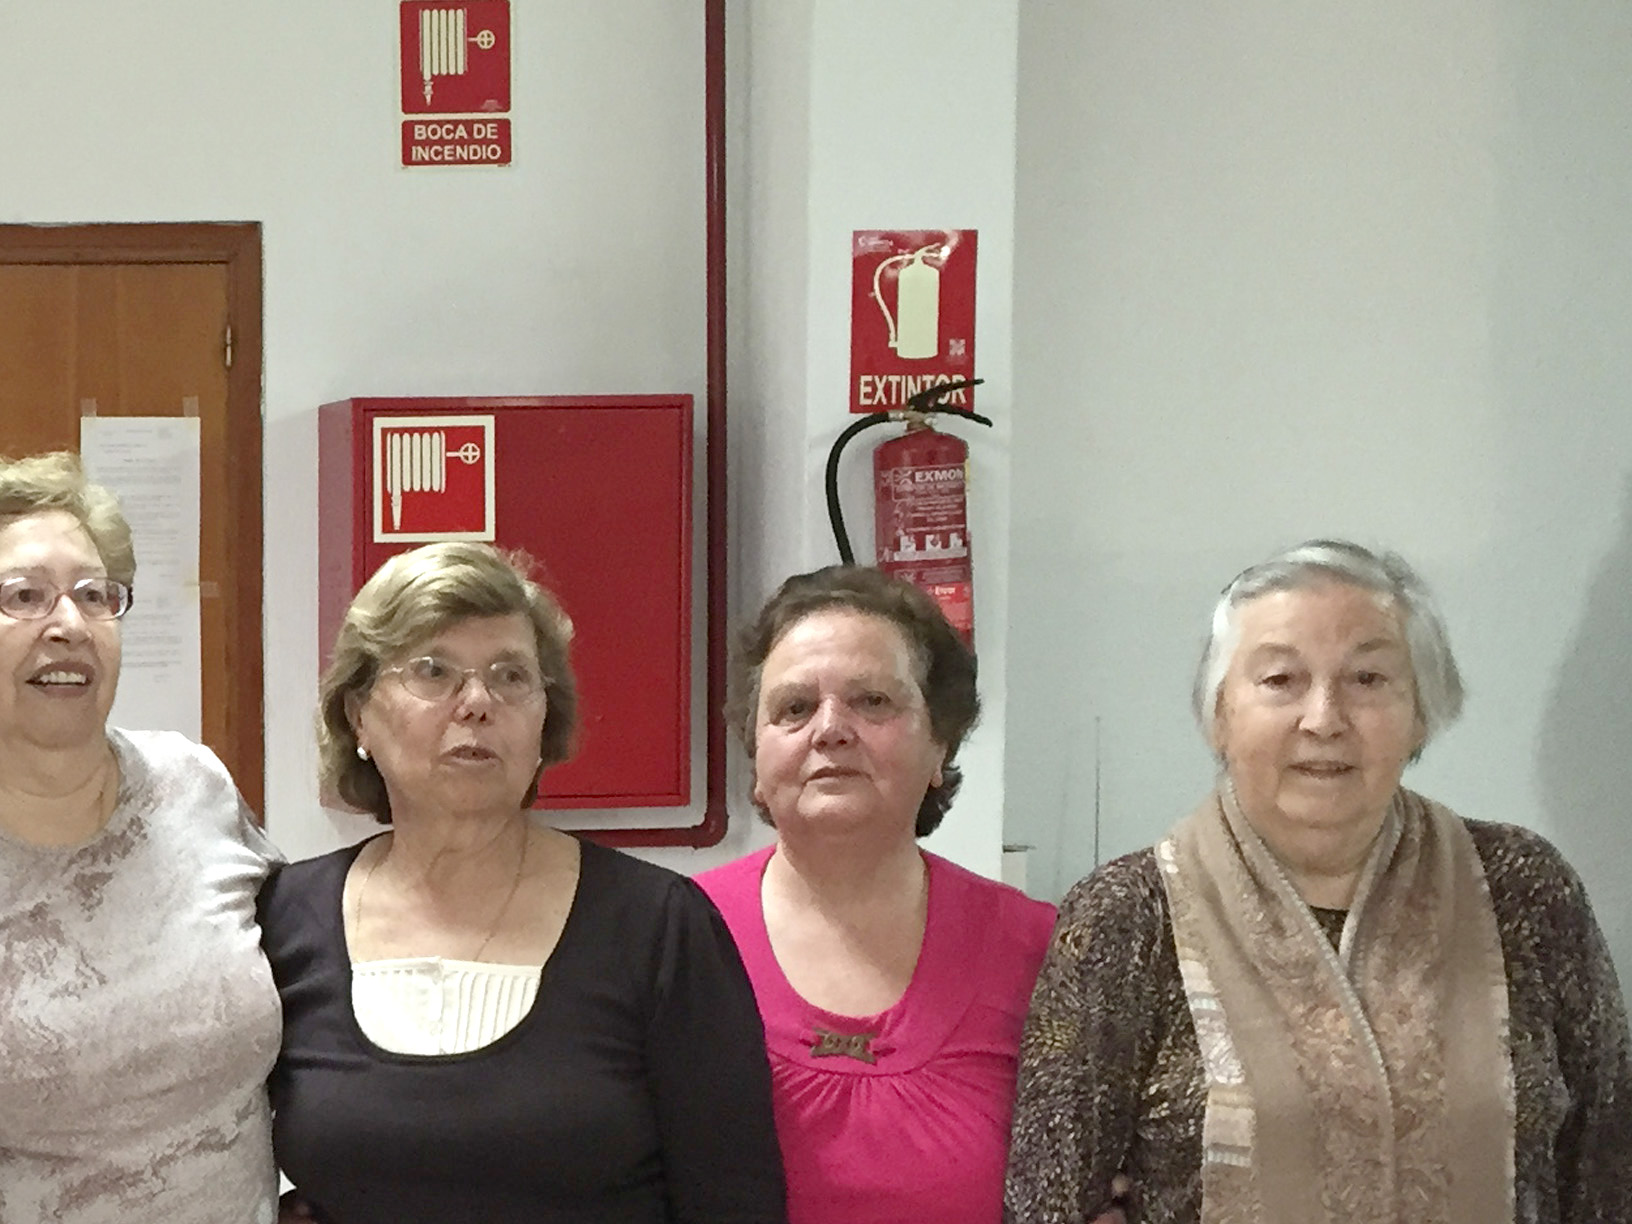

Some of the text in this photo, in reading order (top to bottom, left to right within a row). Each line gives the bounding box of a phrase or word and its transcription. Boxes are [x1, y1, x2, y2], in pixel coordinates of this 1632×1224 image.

[413, 123, 499, 140] BOCA DE
[411, 144, 502, 161] INCENDIO
